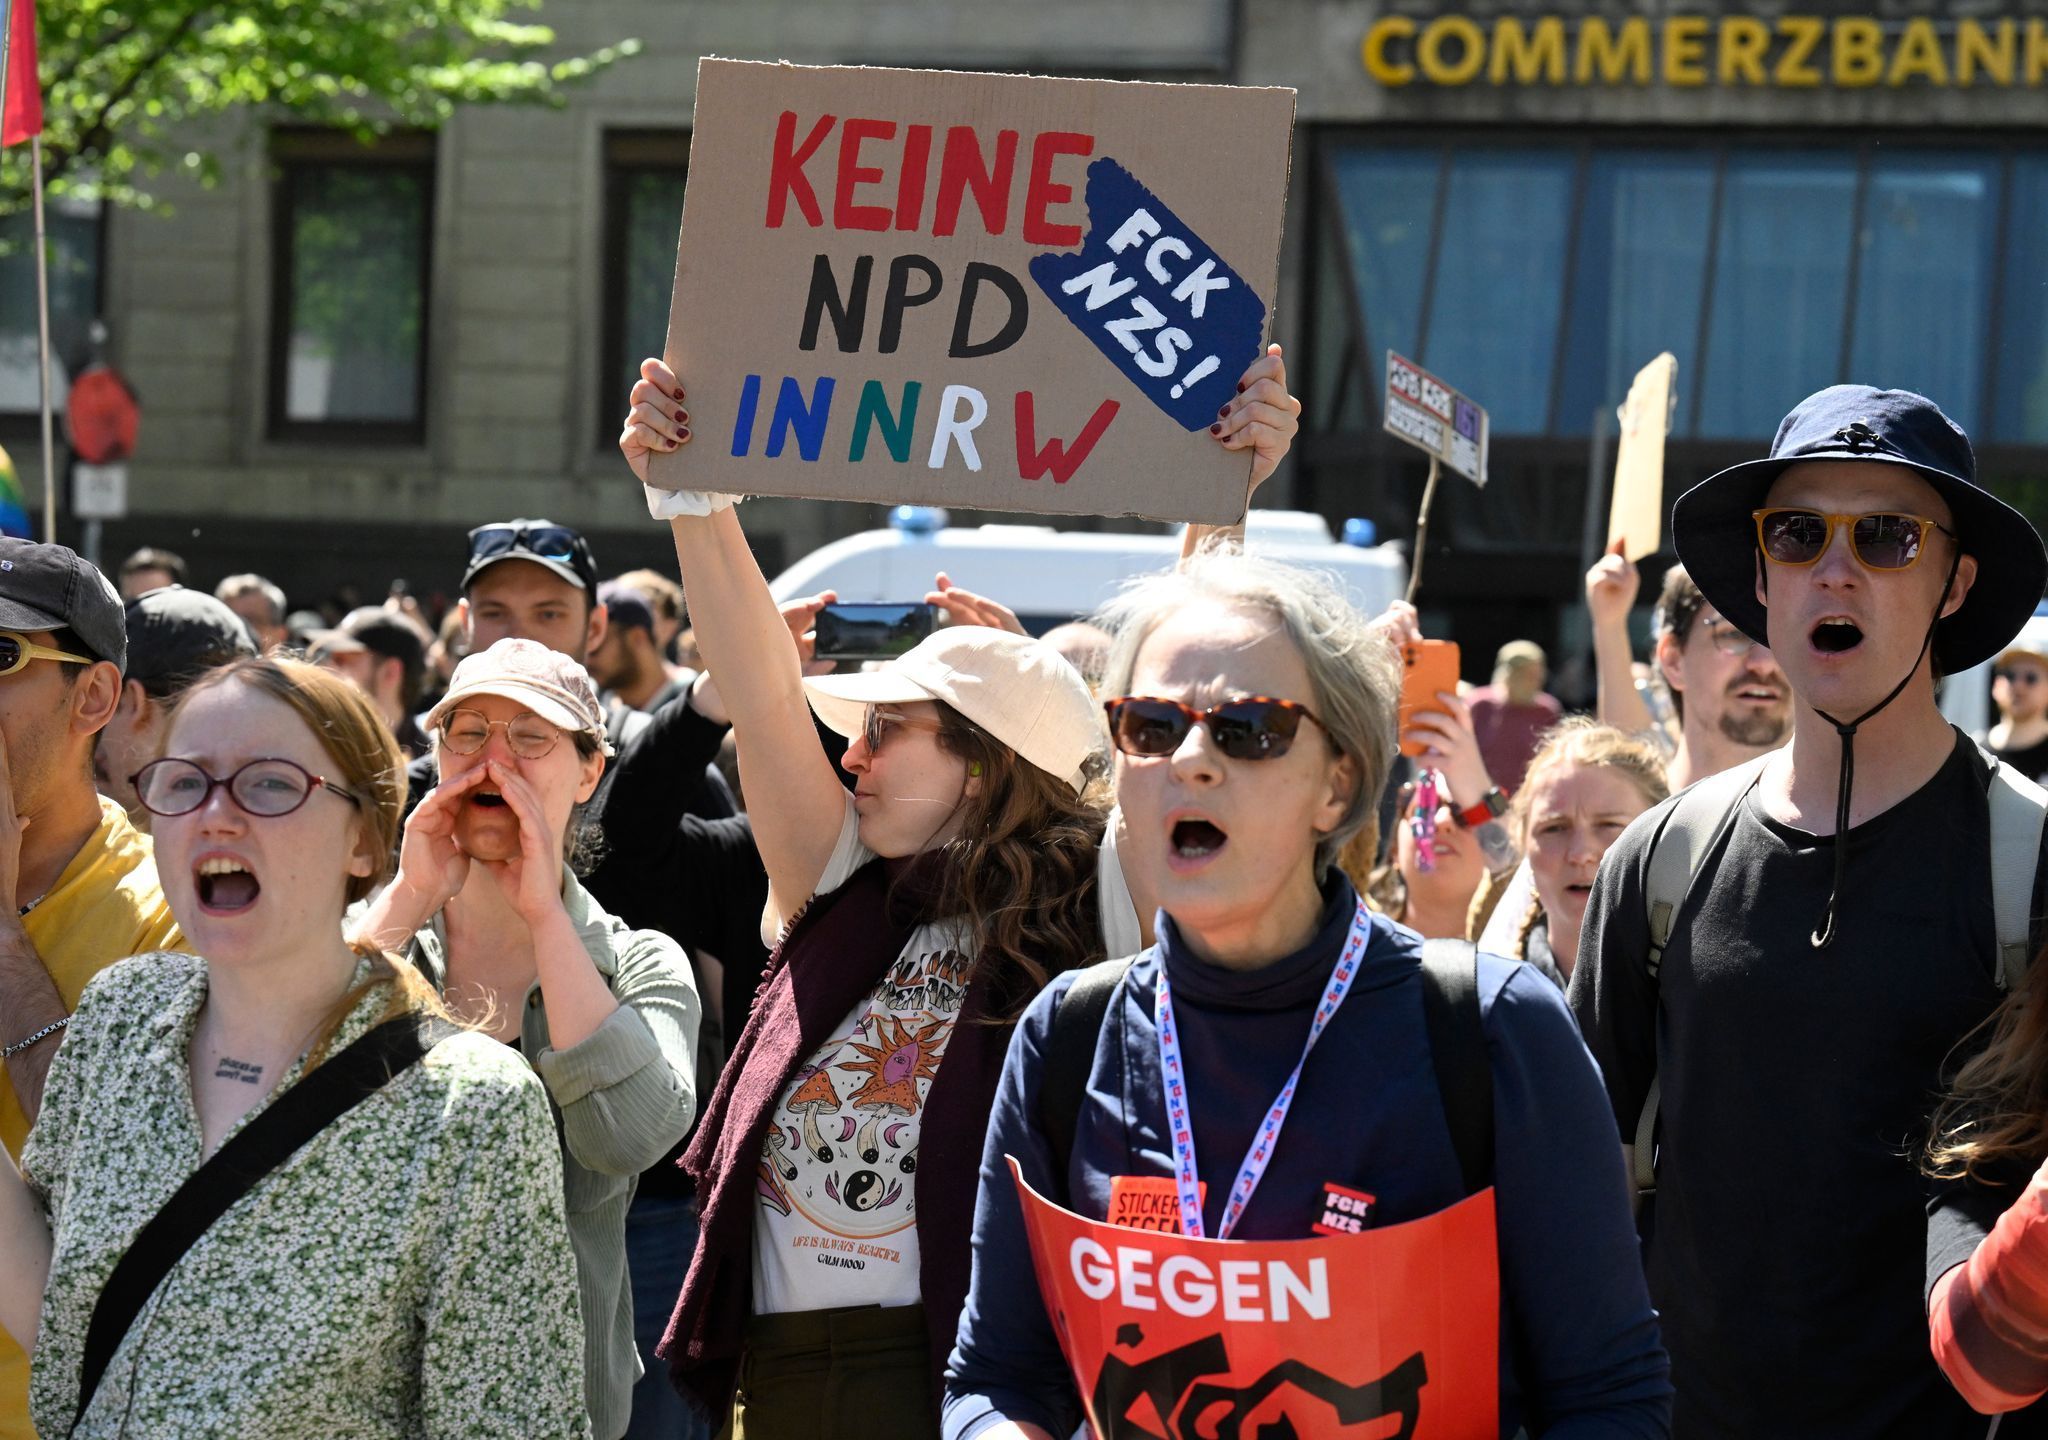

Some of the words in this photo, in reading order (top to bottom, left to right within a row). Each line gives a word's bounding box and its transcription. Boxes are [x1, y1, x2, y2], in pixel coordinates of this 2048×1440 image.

[765, 110, 1095, 246] KEINE
[798, 254, 1029, 358] NPD
[1106, 208, 1230, 318] FCK
[1061, 261, 1221, 399] NZS!
[731, 374, 836, 462] IN
[848, 379, 1121, 484] NRW
[820, 1237, 856, 1253] ALWAYS
[1321, 1210, 1362, 1234] NZS
[1326, 1192, 1368, 1217] FCK
[817, 1253, 840, 1267] CALM
[840, 1259, 866, 1271] MOOD
[1070, 1236, 1330, 1322] GEGEN
